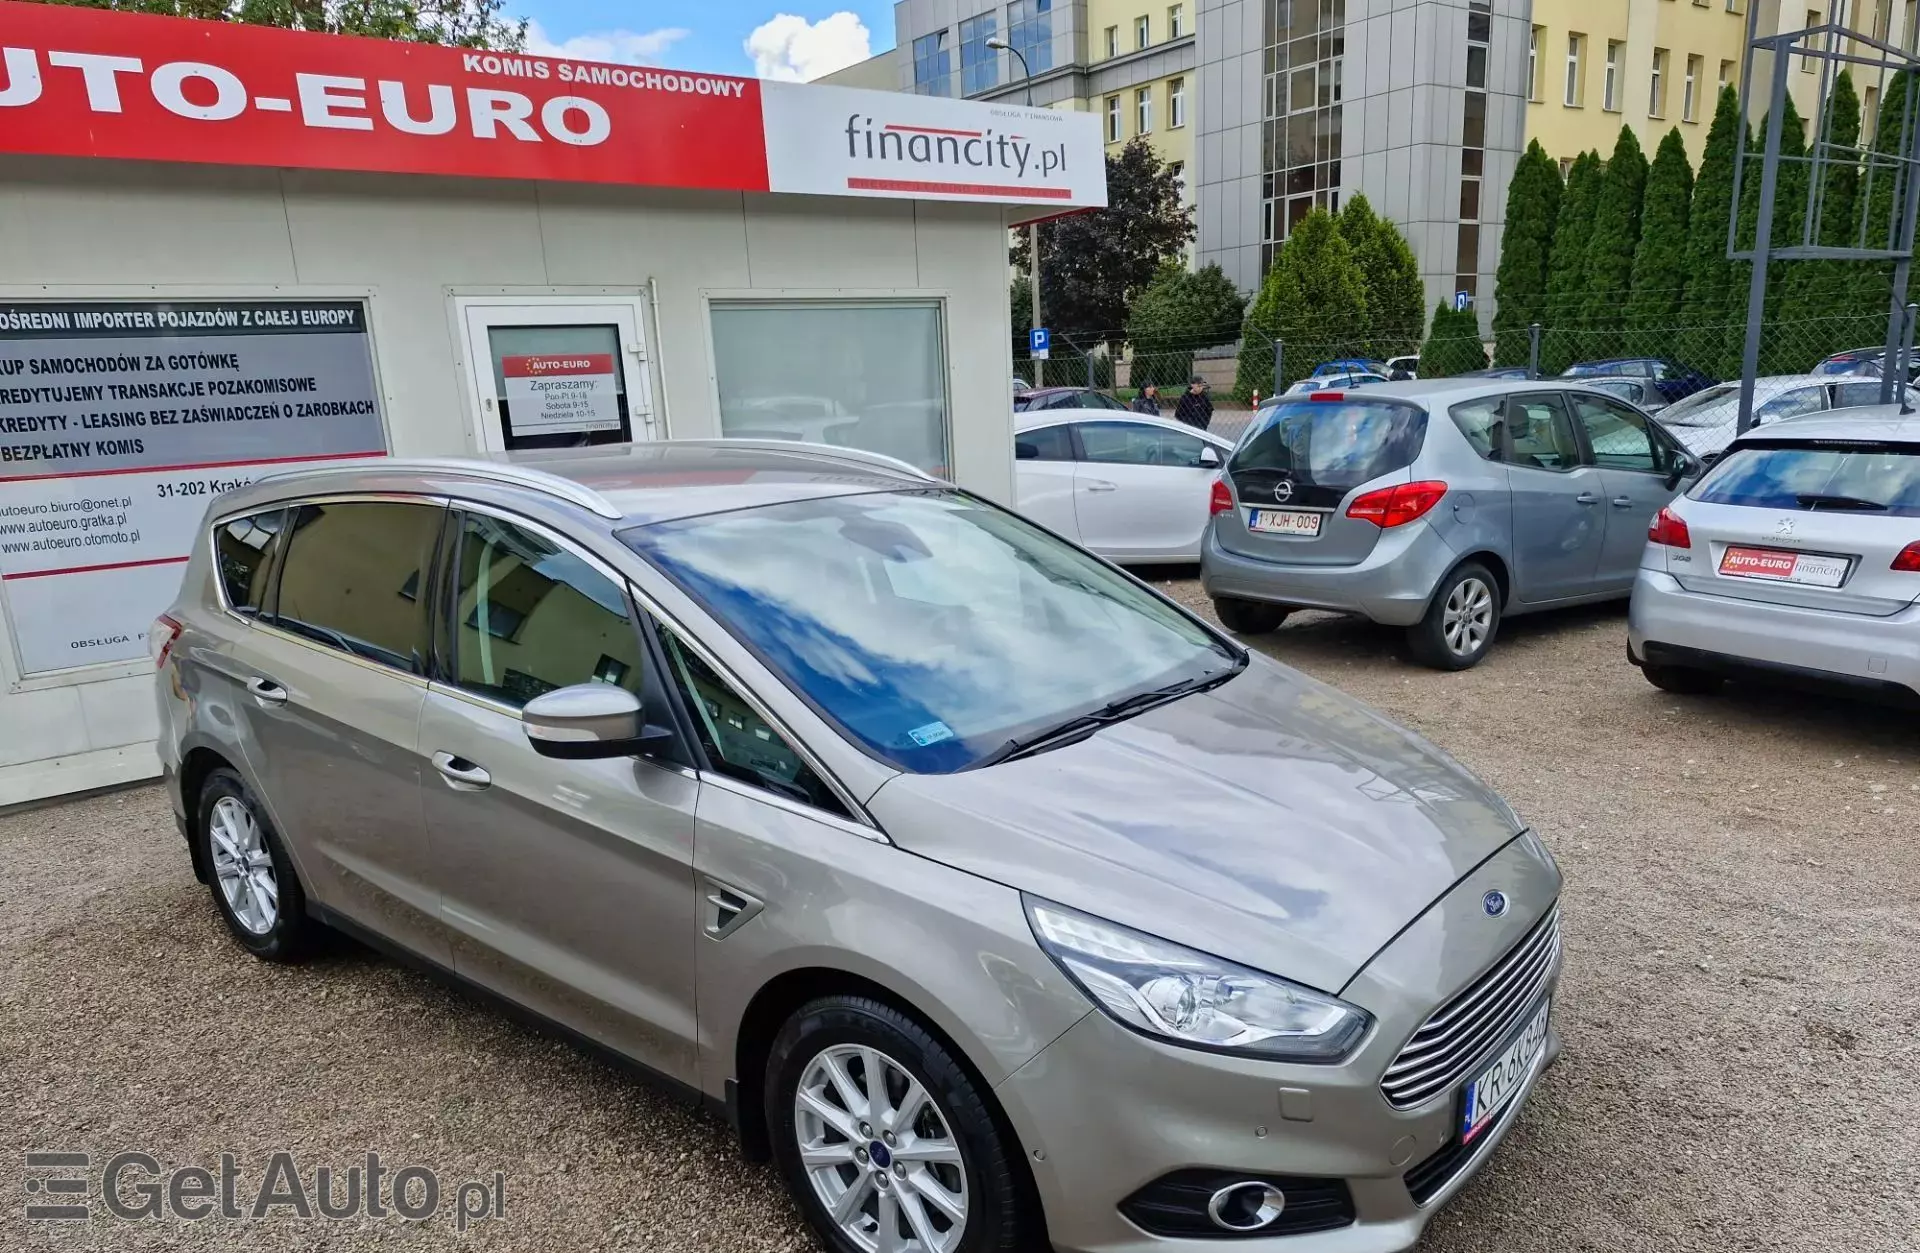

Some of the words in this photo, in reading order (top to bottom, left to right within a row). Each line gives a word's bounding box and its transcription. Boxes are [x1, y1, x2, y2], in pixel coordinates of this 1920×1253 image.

[462, 53, 550, 79] KOMIS
[558, 63, 745, 98] SAMOCHODOWY
[845, 113, 1066, 178] financity.pl
[74, 312, 155, 329] IMPORTER
[158, 308, 237, 328] POJAZDÓW
[241, 311, 252, 326] Z
[254, 310, 298, 326] CAŁEJ
[301, 309, 355, 325] EUROPY
[29, 353, 141, 374] SAMOCHODÓW
[144, 355, 165, 371] ZA
[168, 351, 240, 372] GOTÓWKĘ
[531, 360, 591, 370] AUTO-EURO
[108, 382, 205, 400] TRANSAKCJE
[208, 377, 317, 395] POZAKOMISOWE
[530, 379, 598, 393] Zapraszamy:
[81, 411, 146, 429] LEASING
[150, 409, 179, 426] BEZ
[183, 401, 280, 424] ZAŚWIADCZEŃ
[283, 404, 294, 418] O
[296, 400, 374, 418] ZAROBKACH
[545, 402, 571, 410] Sobota
[572, 400, 589, 409] 9-15
[1, 441, 91, 461] BEZPŁATNY
[96, 438, 144, 456] KOMIS
[156, 481, 206, 498] 31-202
[2, 529, 140, 553] www.autoeuro.otomoto.pl
[1729, 556, 1792, 570] AUTO-EURO
[71, 634, 130, 649] OBSŁUGA
[1476, 1061, 1503, 1118] KR
